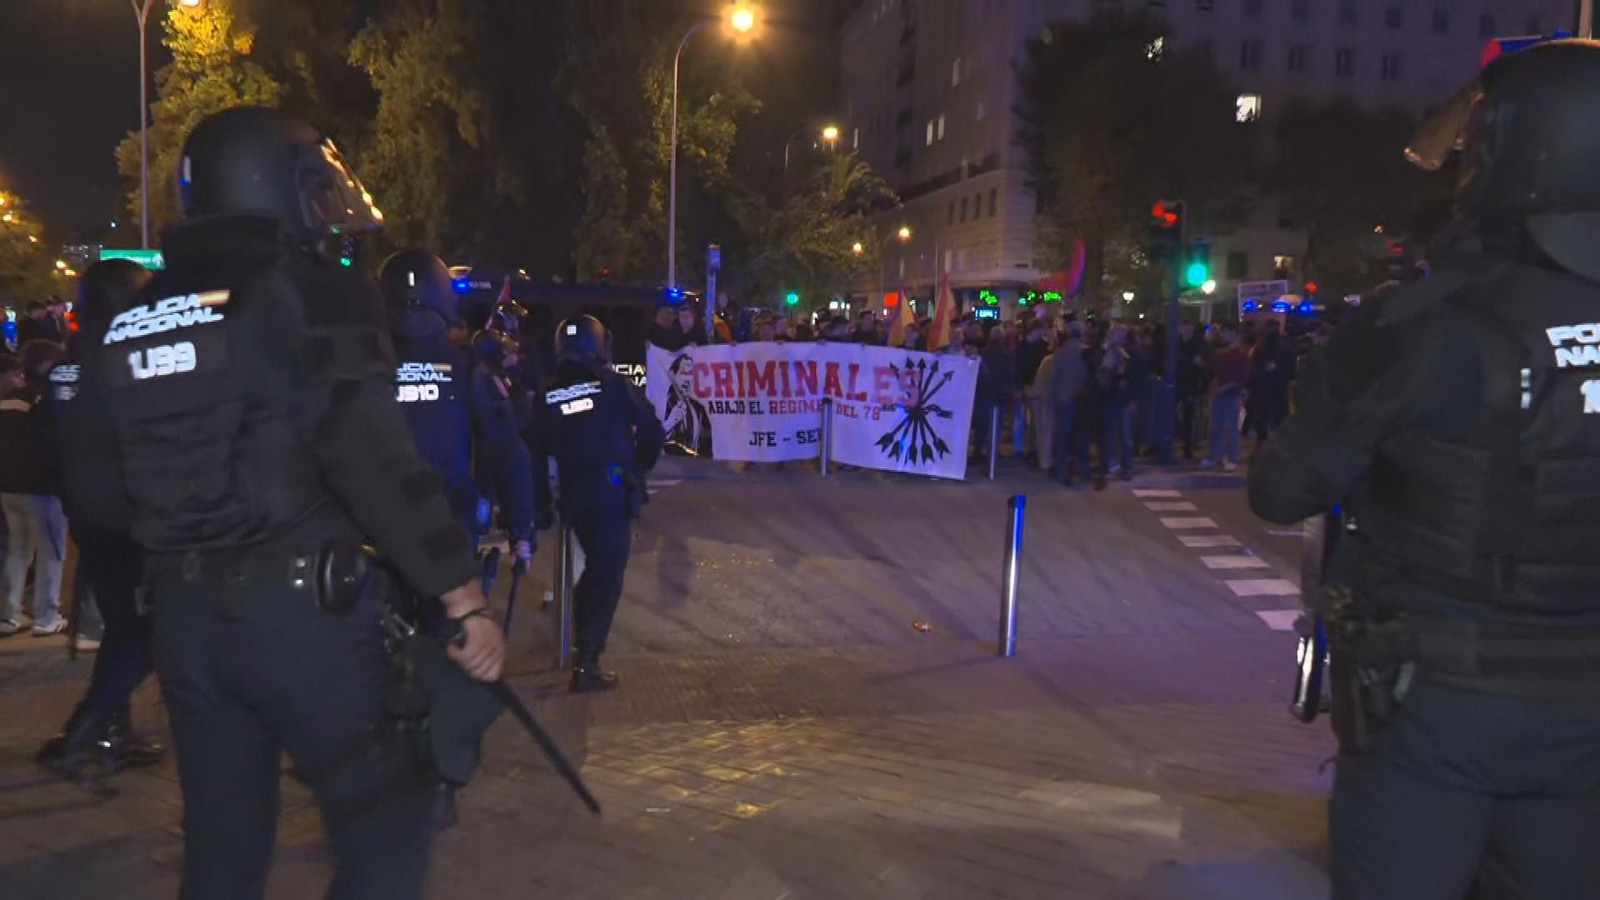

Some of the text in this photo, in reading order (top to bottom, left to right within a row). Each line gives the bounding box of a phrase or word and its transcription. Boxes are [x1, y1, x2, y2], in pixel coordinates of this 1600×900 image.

[693, 359, 921, 407] CRIMINALES
[708, 401, 745, 414] ABAJO
[750, 401, 765, 415] EL
[837, 402, 859, 418] DEL
[864, 405, 881, 421] 78
[749, 431, 777, 447] JFE
